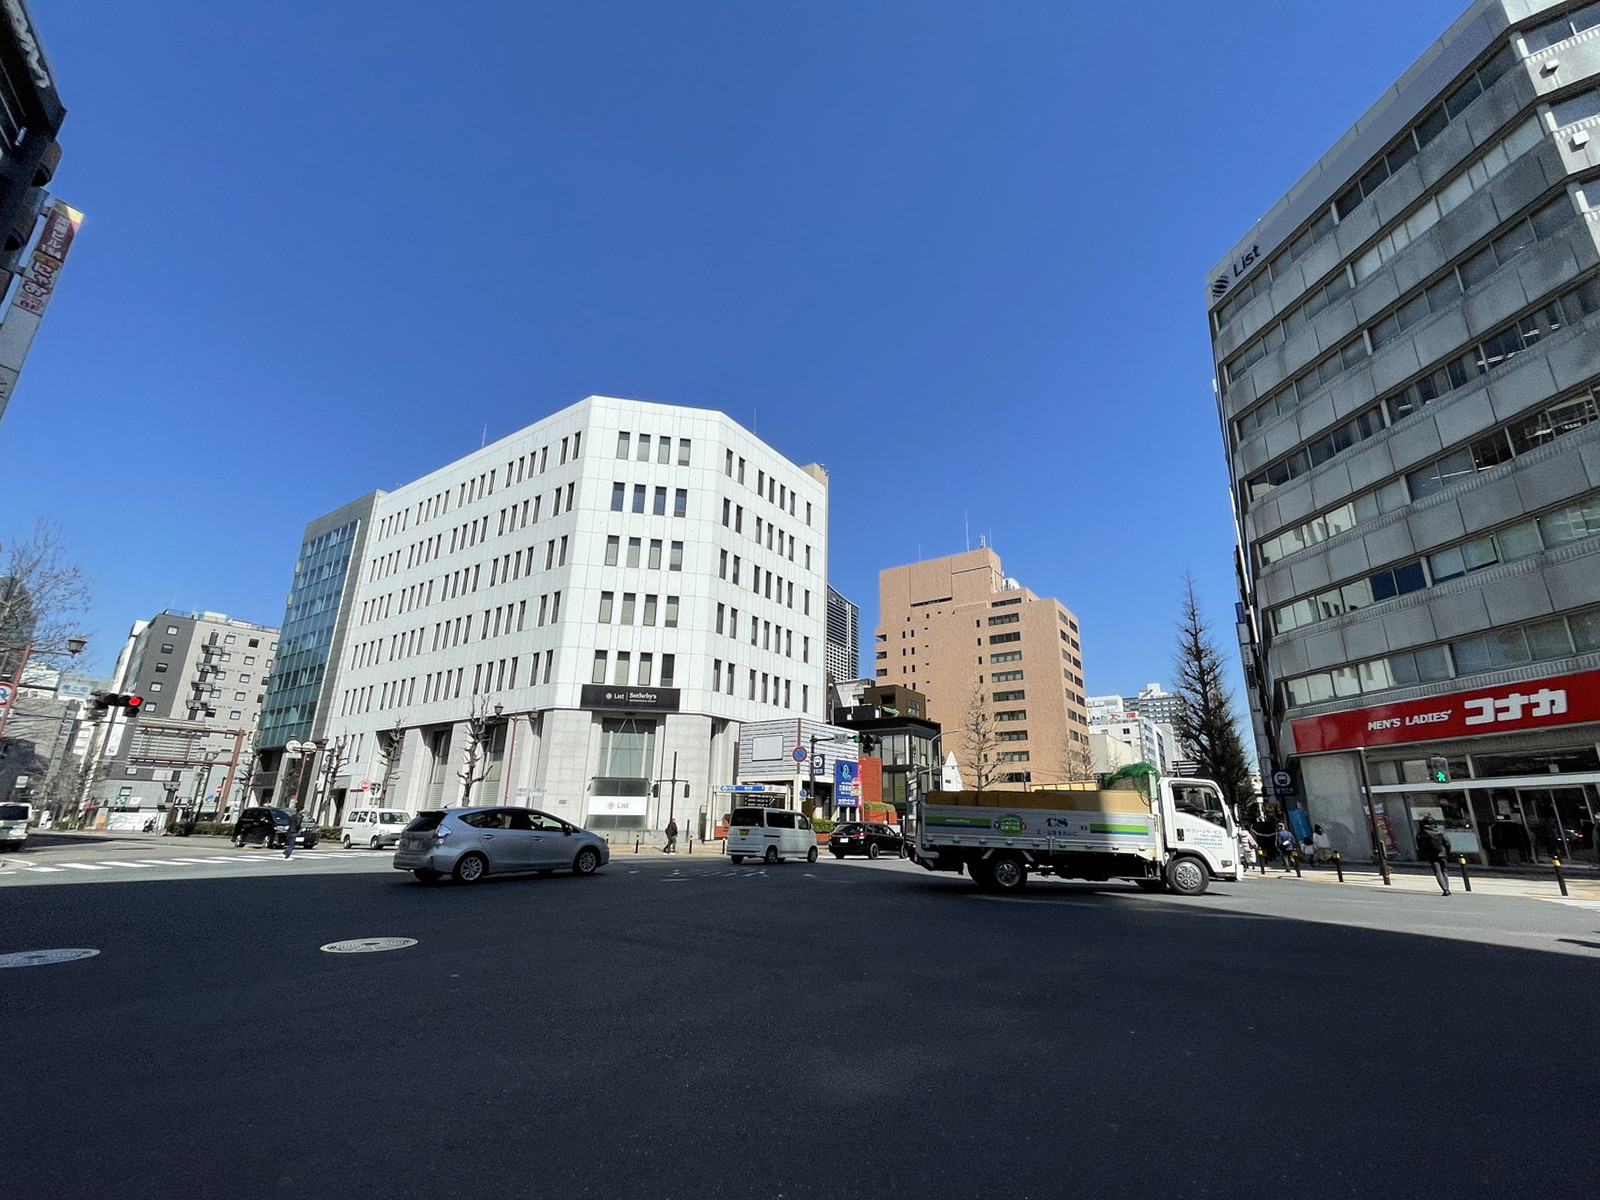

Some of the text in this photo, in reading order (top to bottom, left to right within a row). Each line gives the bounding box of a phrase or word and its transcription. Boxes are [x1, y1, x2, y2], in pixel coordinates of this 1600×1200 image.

[1233, 245, 1260, 277] List
[614, 692, 657, 700] List Sotheby's
[1367, 688, 1568, 731] MEN'S LADIES' コナカ
